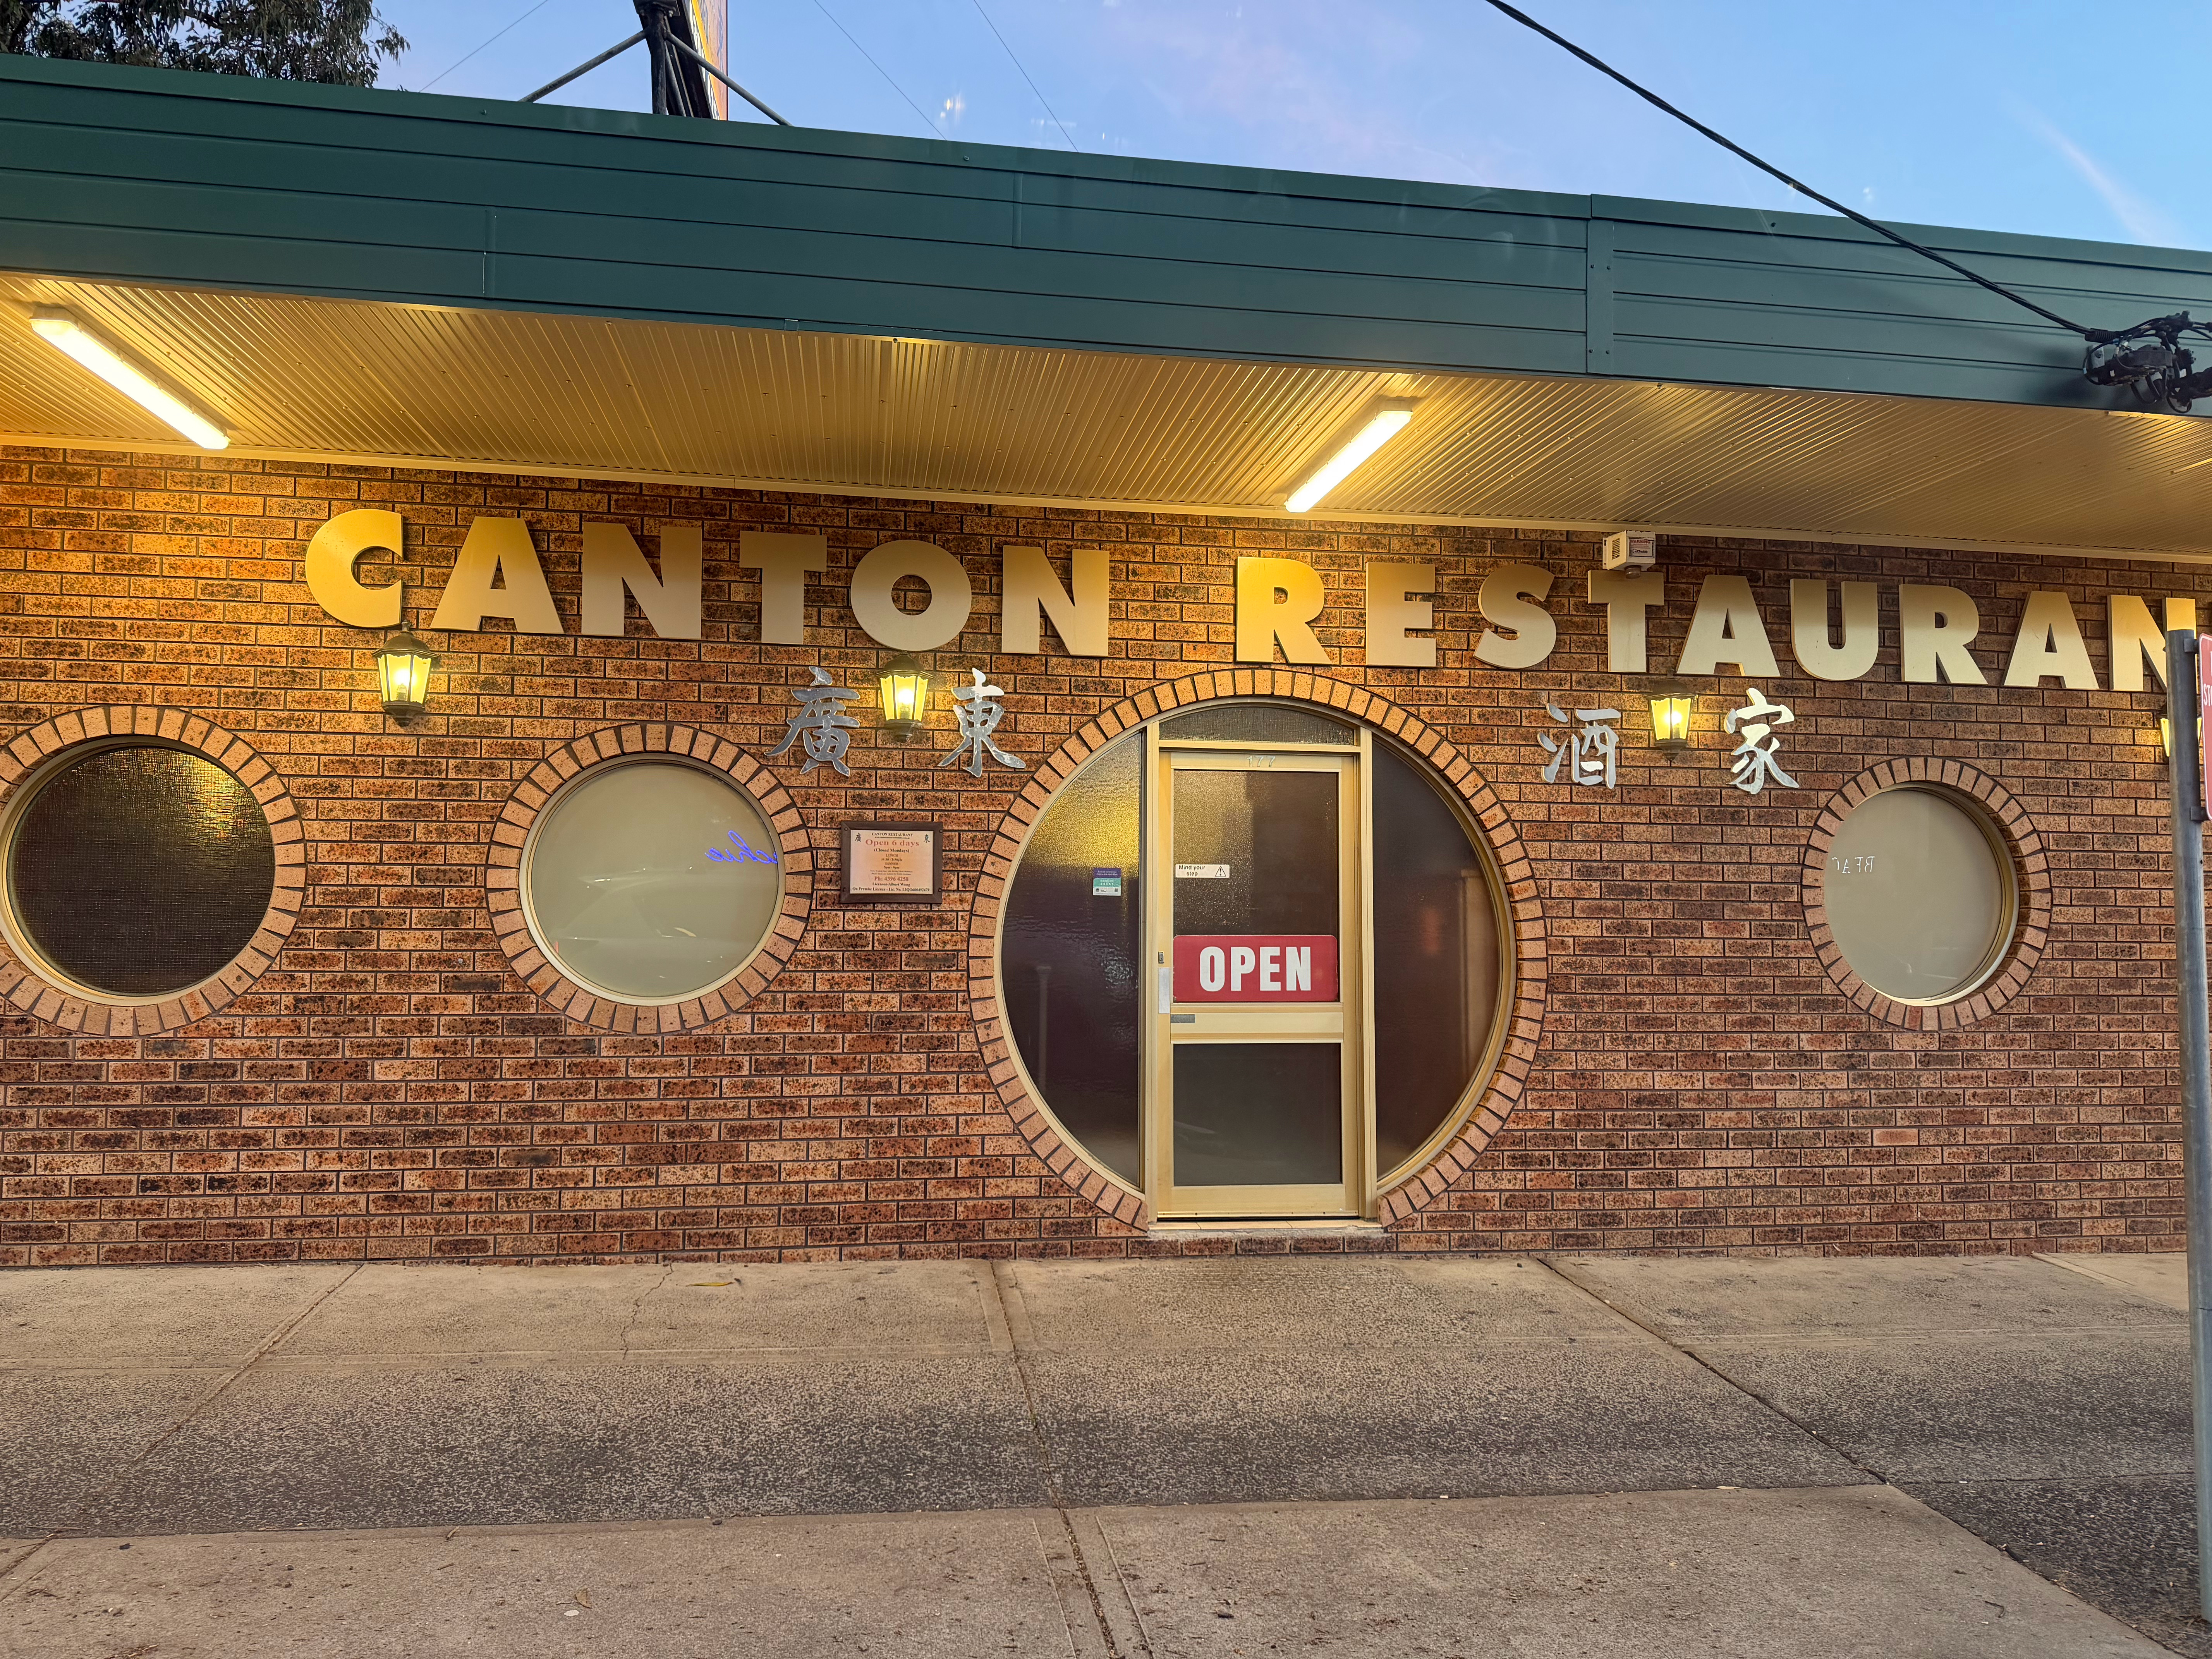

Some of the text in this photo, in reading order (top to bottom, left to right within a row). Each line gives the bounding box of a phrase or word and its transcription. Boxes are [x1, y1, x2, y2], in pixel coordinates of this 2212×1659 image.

[305, 508, 2199, 694] CANTON RESTAURAN
[1247, 756, 1276, 767] 177
[866, 839, 889, 847] Open
[1199, 946, 1312, 992] OPEN
